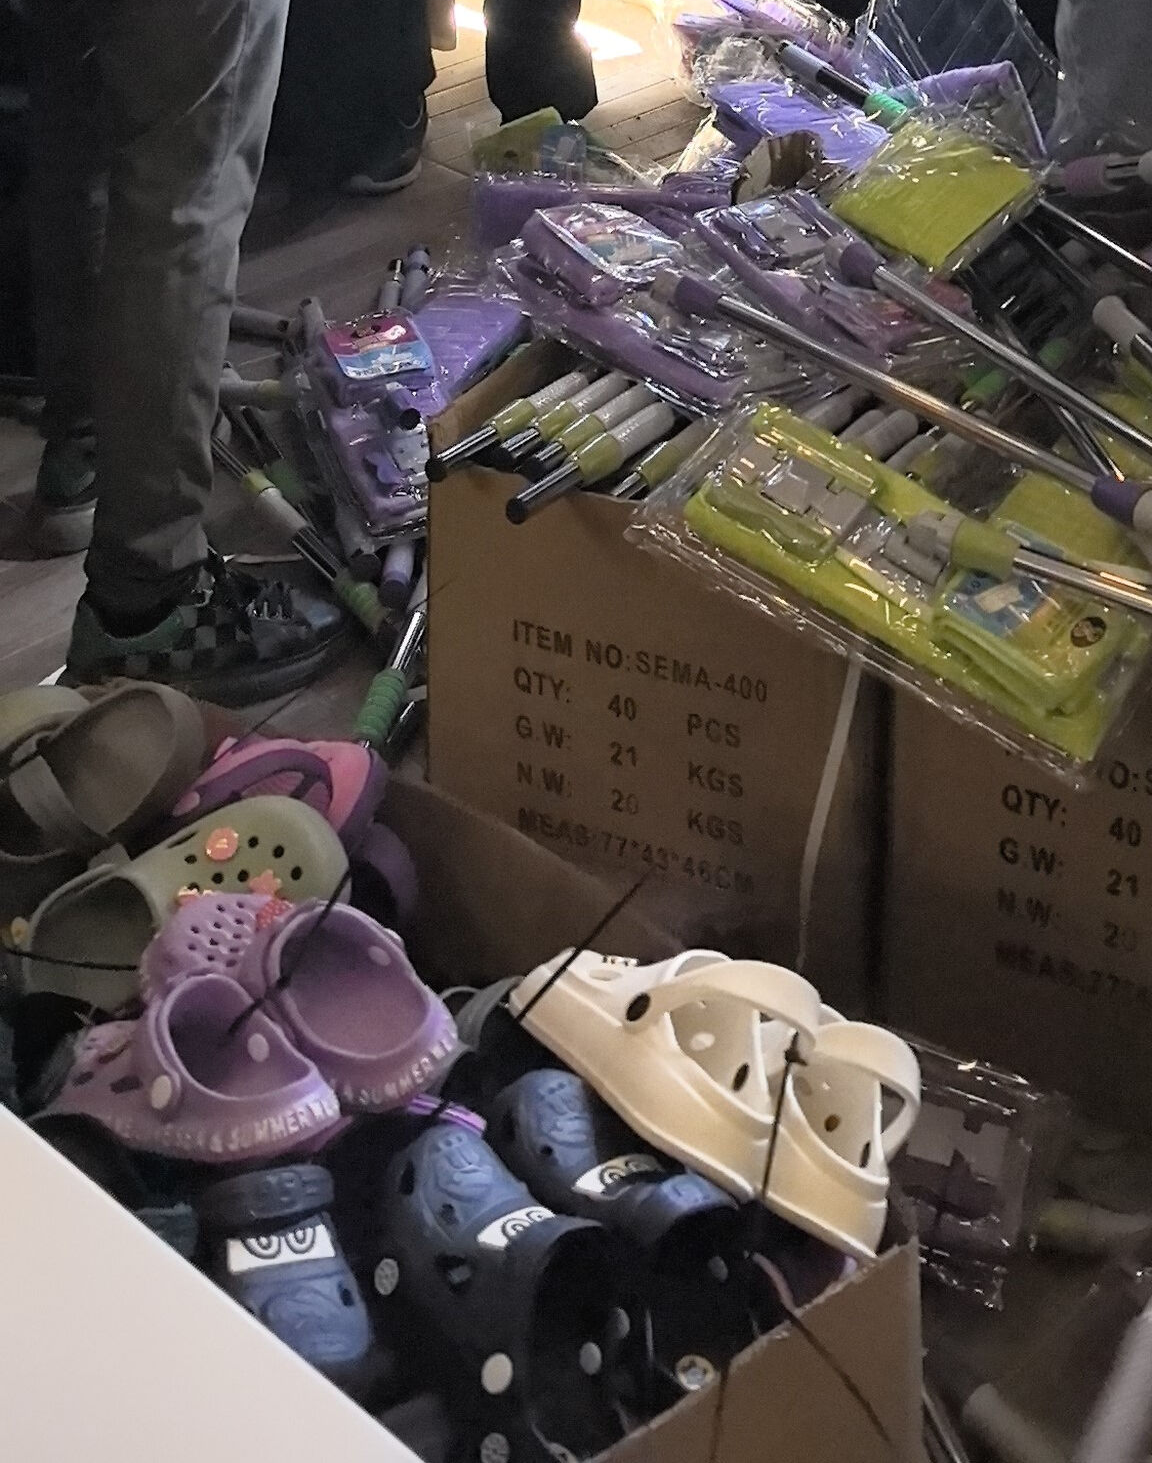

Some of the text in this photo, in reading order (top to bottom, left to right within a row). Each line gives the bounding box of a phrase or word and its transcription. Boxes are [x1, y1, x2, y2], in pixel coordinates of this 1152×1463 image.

[513, 619, 572, 658] ITEM
[513, 666, 741, 748] QTY: 40 PCS
[609, 741, 637, 767] 21
[688, 761, 743, 798] KGS
[611, 788, 639, 815] 20
[687, 808, 743, 846] KGS
[1001, 784, 1067, 828] QTY:
[1109, 817, 1142, 847] 40
[1107, 868, 1139, 898] 21
